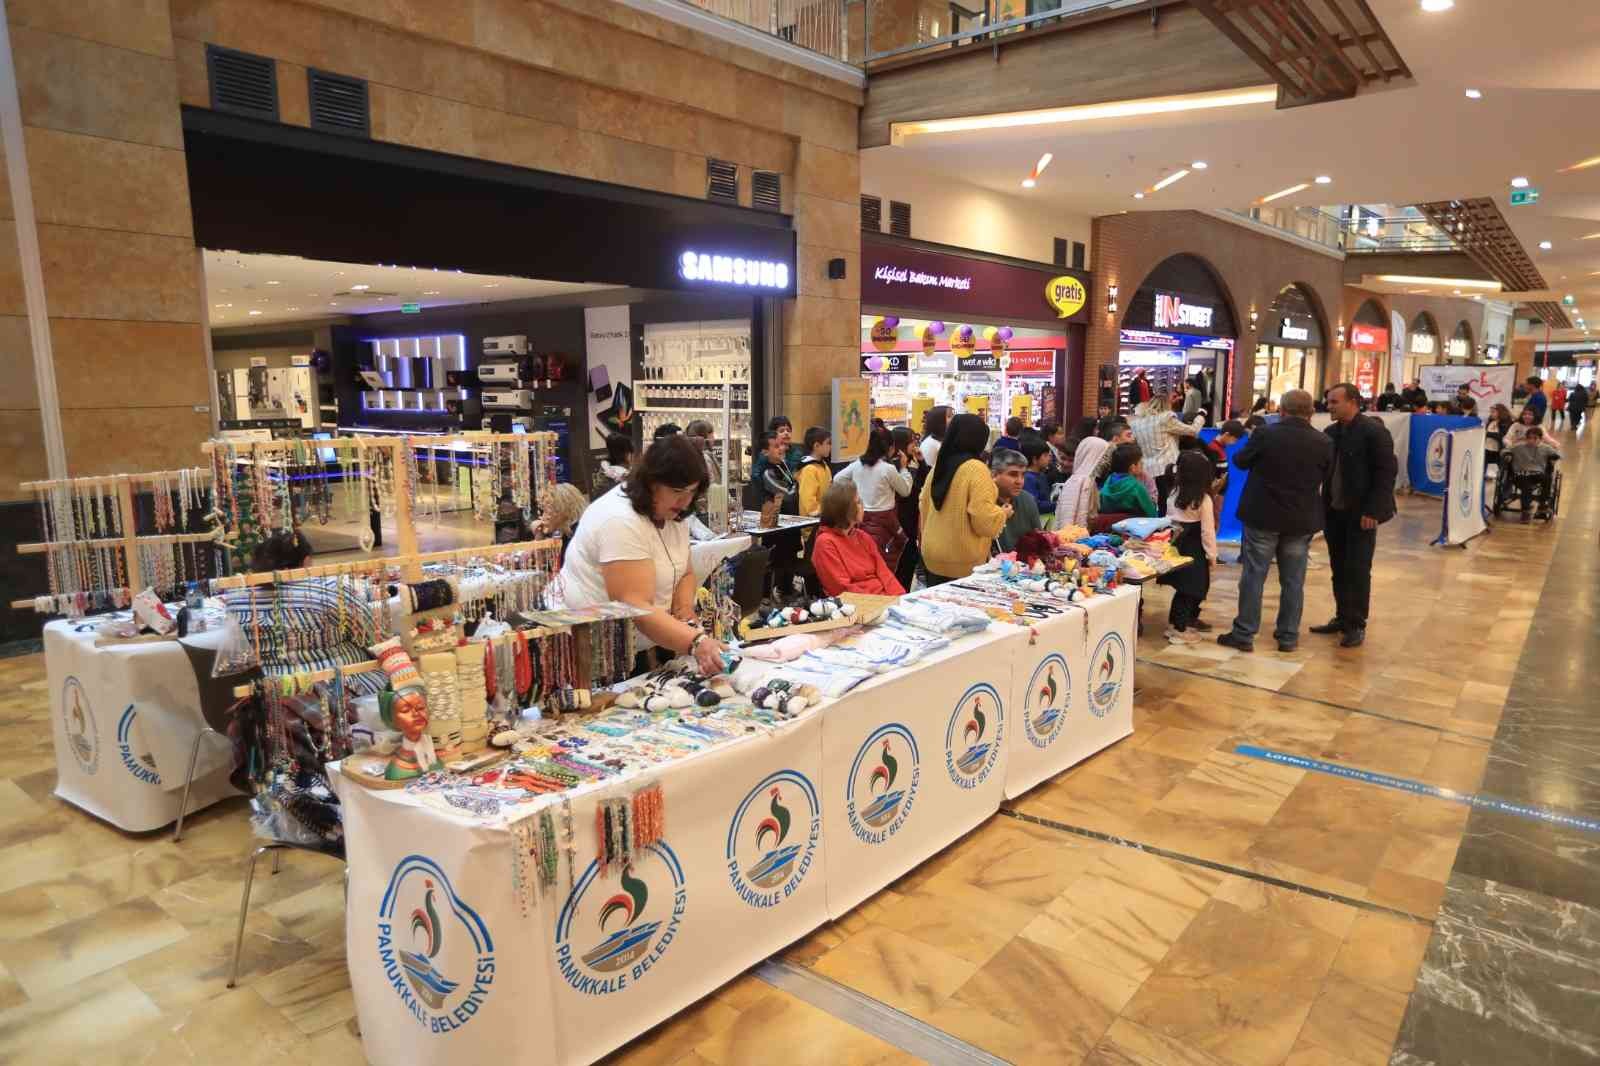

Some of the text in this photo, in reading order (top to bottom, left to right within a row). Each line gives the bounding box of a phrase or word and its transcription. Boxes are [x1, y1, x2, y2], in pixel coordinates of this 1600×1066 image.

[680, 251, 789, 289] SAMSUNG
[875, 266, 908, 285] Kişisel
[938, 276, 972, 290] Marketi
[1055, 282, 1082, 303] gratis
[846, 802, 887, 845] PAMUKKALE
[727, 860, 781, 908] PAMUKKALE
[377, 923, 495, 1034] PAMUKKALE BELEDİYESİ
[556, 943, 627, 996] PAMUKKALE
